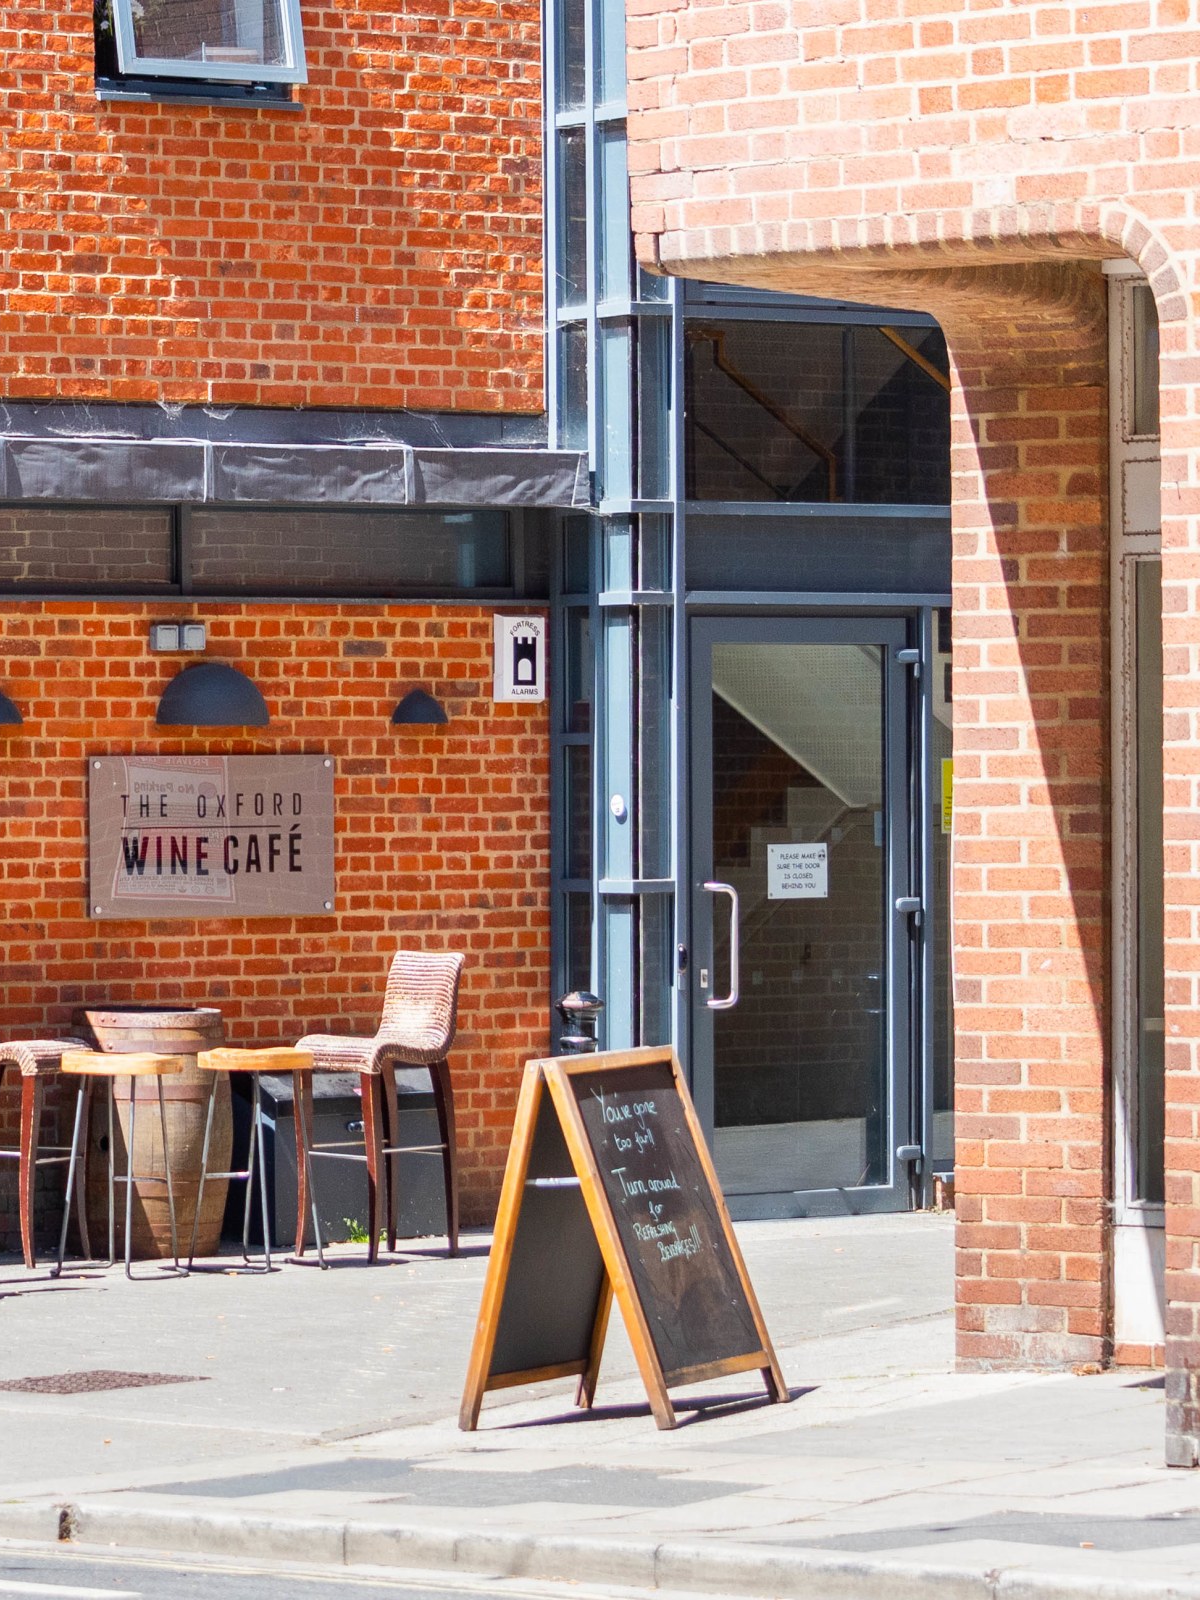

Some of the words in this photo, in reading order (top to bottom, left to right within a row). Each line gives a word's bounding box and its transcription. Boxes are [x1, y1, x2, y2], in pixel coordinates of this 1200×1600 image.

[509, 620, 540, 637] FORTRESS
[120, 794, 167, 817] THE
[197, 793, 302, 818] OXFORD
[121, 836, 209, 875] WINE
[224, 823, 302, 875] CAFÉ
[590, 1085, 633, 1123] You've
[632, 1101, 657, 1130] gone
[613, 1133, 632, 1151] too
[611, 1167, 648, 1197] Turn
[648, 1168, 680, 1192] around
[648, 1200, 663, 1222] for
